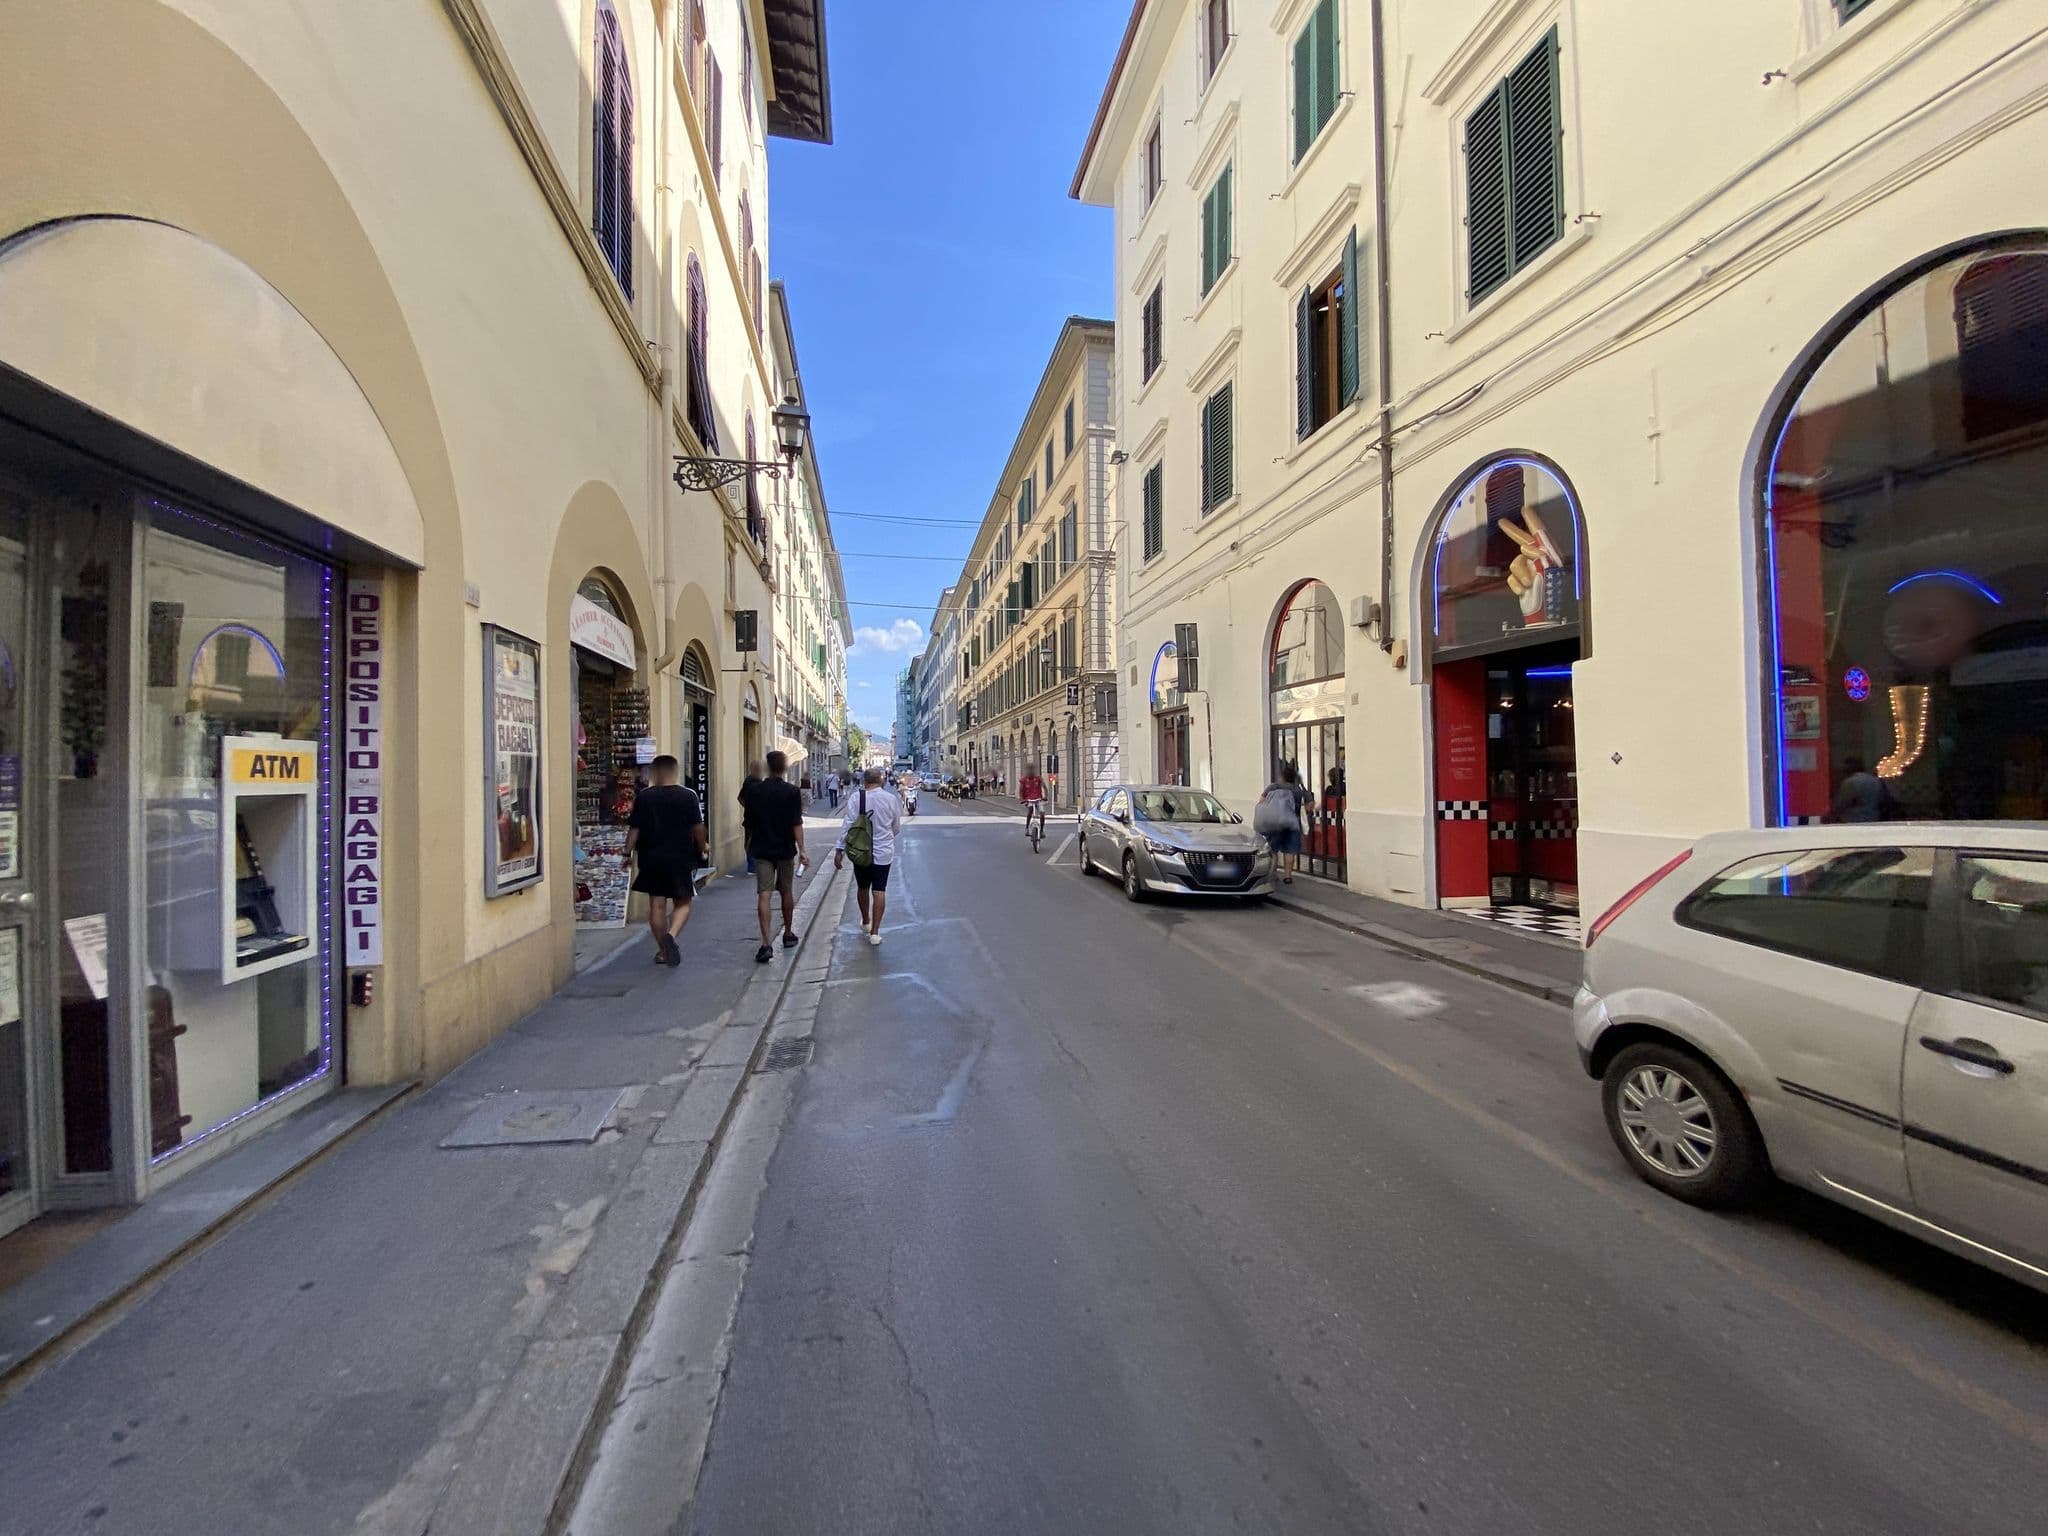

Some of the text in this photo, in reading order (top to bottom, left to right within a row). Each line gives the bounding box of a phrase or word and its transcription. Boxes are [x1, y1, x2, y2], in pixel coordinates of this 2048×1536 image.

[249, 754, 300, 779] ATM
[346, 594, 380, 951] DEPOSITO BAGAGLI
